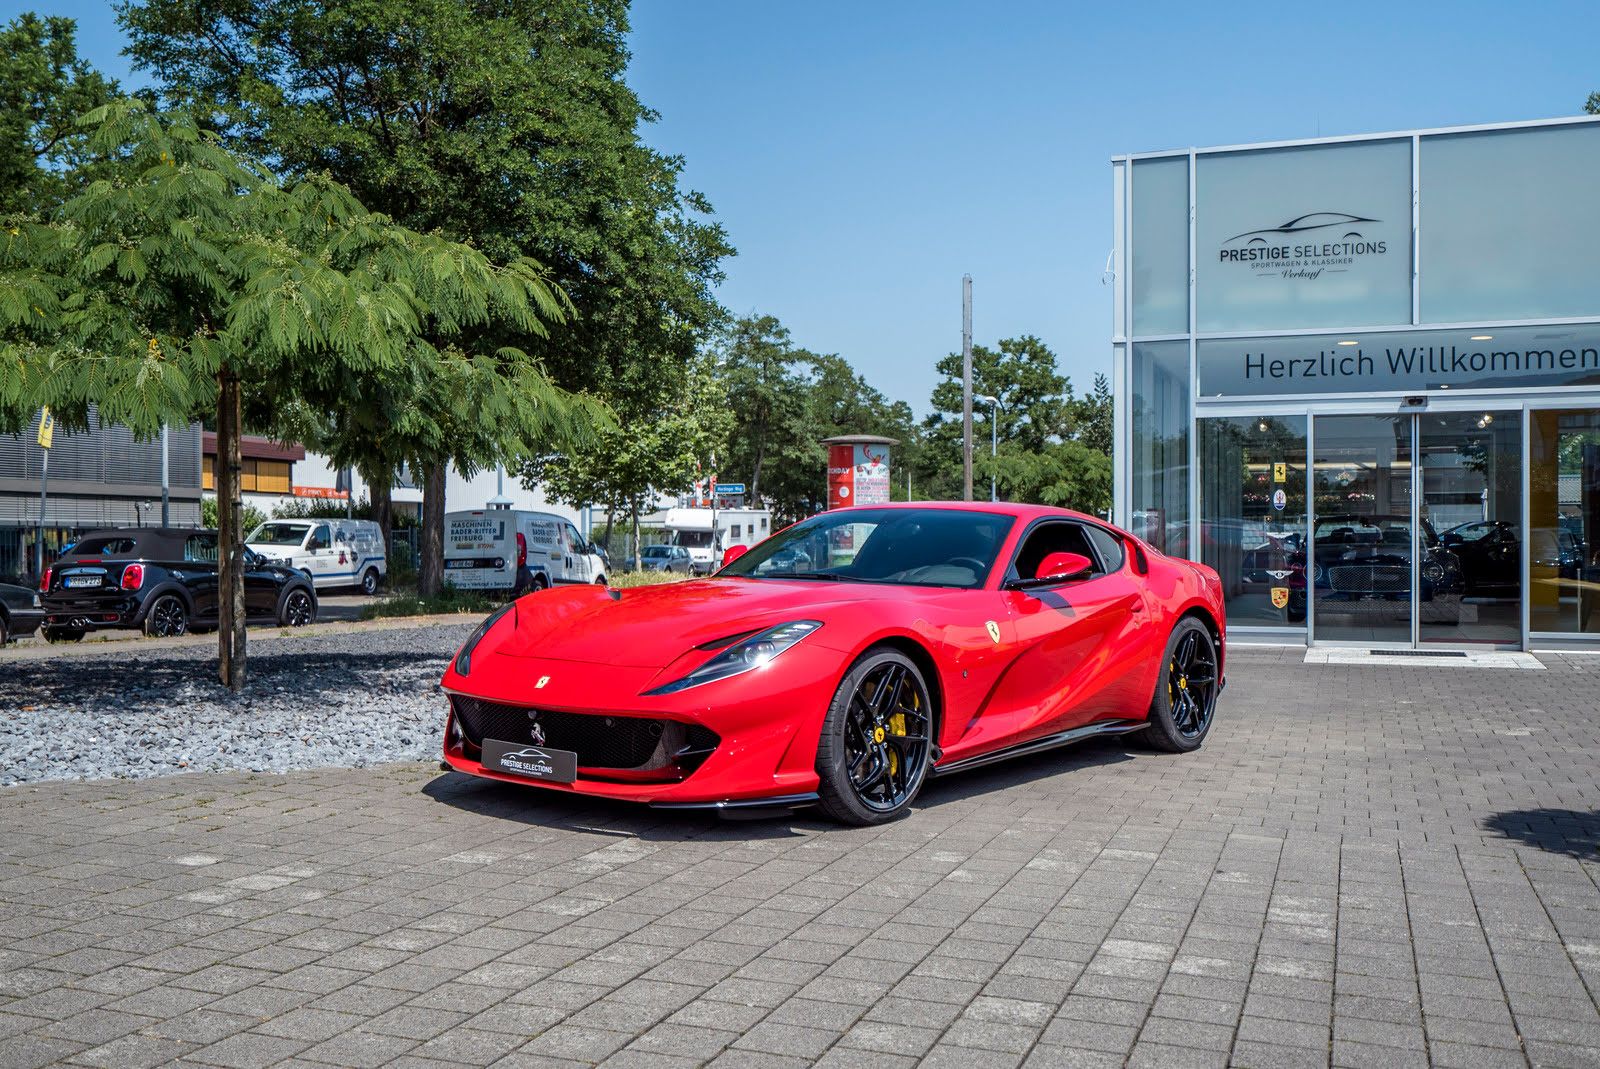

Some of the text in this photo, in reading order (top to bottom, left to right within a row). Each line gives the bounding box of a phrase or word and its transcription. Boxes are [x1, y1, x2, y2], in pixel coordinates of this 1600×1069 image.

[1220, 241, 1387, 262] PRESTIGE SELECTIONS
[1251, 260, 1301, 269] SPORTWAGEN
[1311, 257, 1353, 266] KLASSIKER
[1281, 268, 1324, 280] Verkauf
[1245, 346, 1599, 379] Herzlich Willkommen
[450, 521, 492, 529] MASCHINEN
[450, 528, 497, 536] BADER-RITTER
[500, 759, 553, 773] PRESTIGE SELECTIONS
